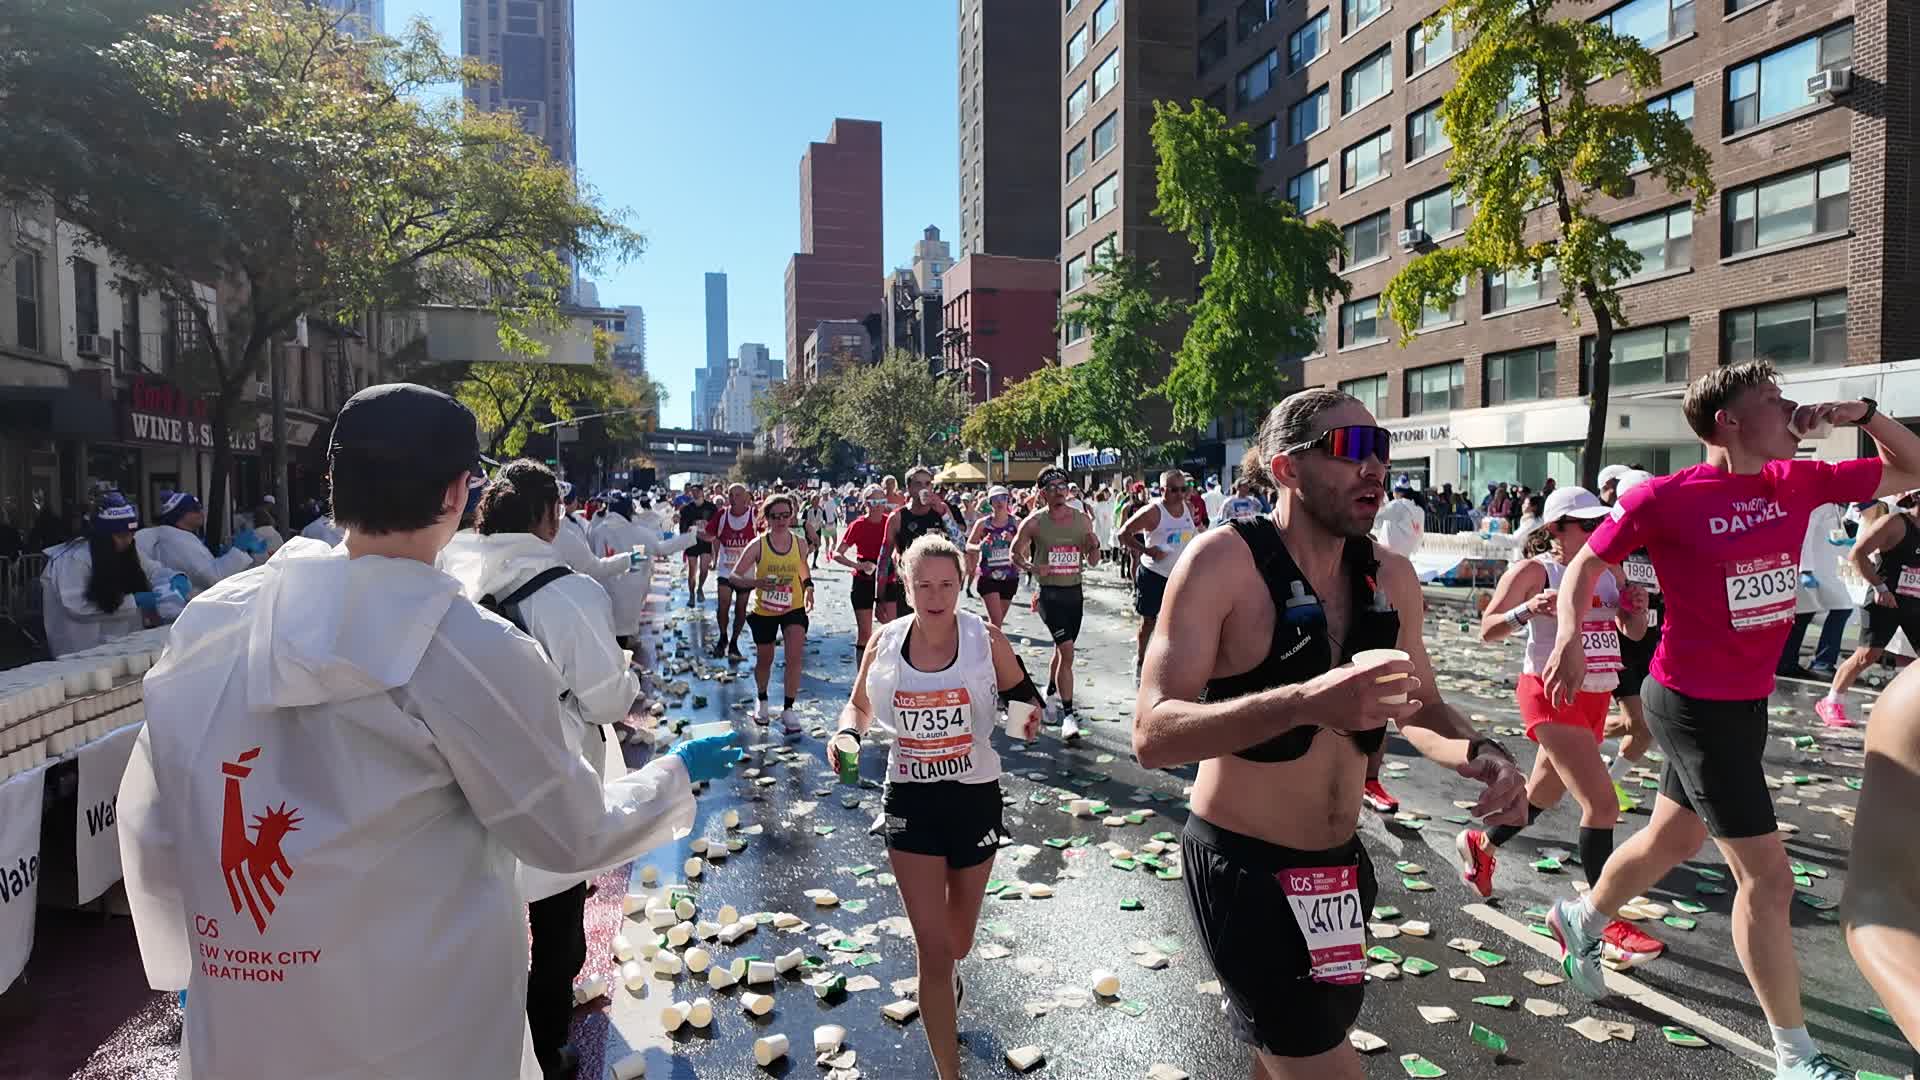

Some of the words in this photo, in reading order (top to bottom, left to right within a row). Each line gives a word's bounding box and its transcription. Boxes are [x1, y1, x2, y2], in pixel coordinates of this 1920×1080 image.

[131, 412, 182, 443] WINE
[1050, 553, 1078, 563] 21203
[1732, 568, 1796, 600] 23033
[1281, 635, 1312, 661] SALOMON
[1584, 632, 1618, 650] 2898
[900, 707, 964, 732] 17354
[911, 754, 973, 780] CLAUDIA
[1290, 874, 1312, 892] tcs
[195, 915, 219, 939] CS
[200, 943, 219, 960] EW
[224, 949, 273, 965] YORK
[277, 949, 322, 965] CITY
[201, 961, 284, 982] ARATHON
